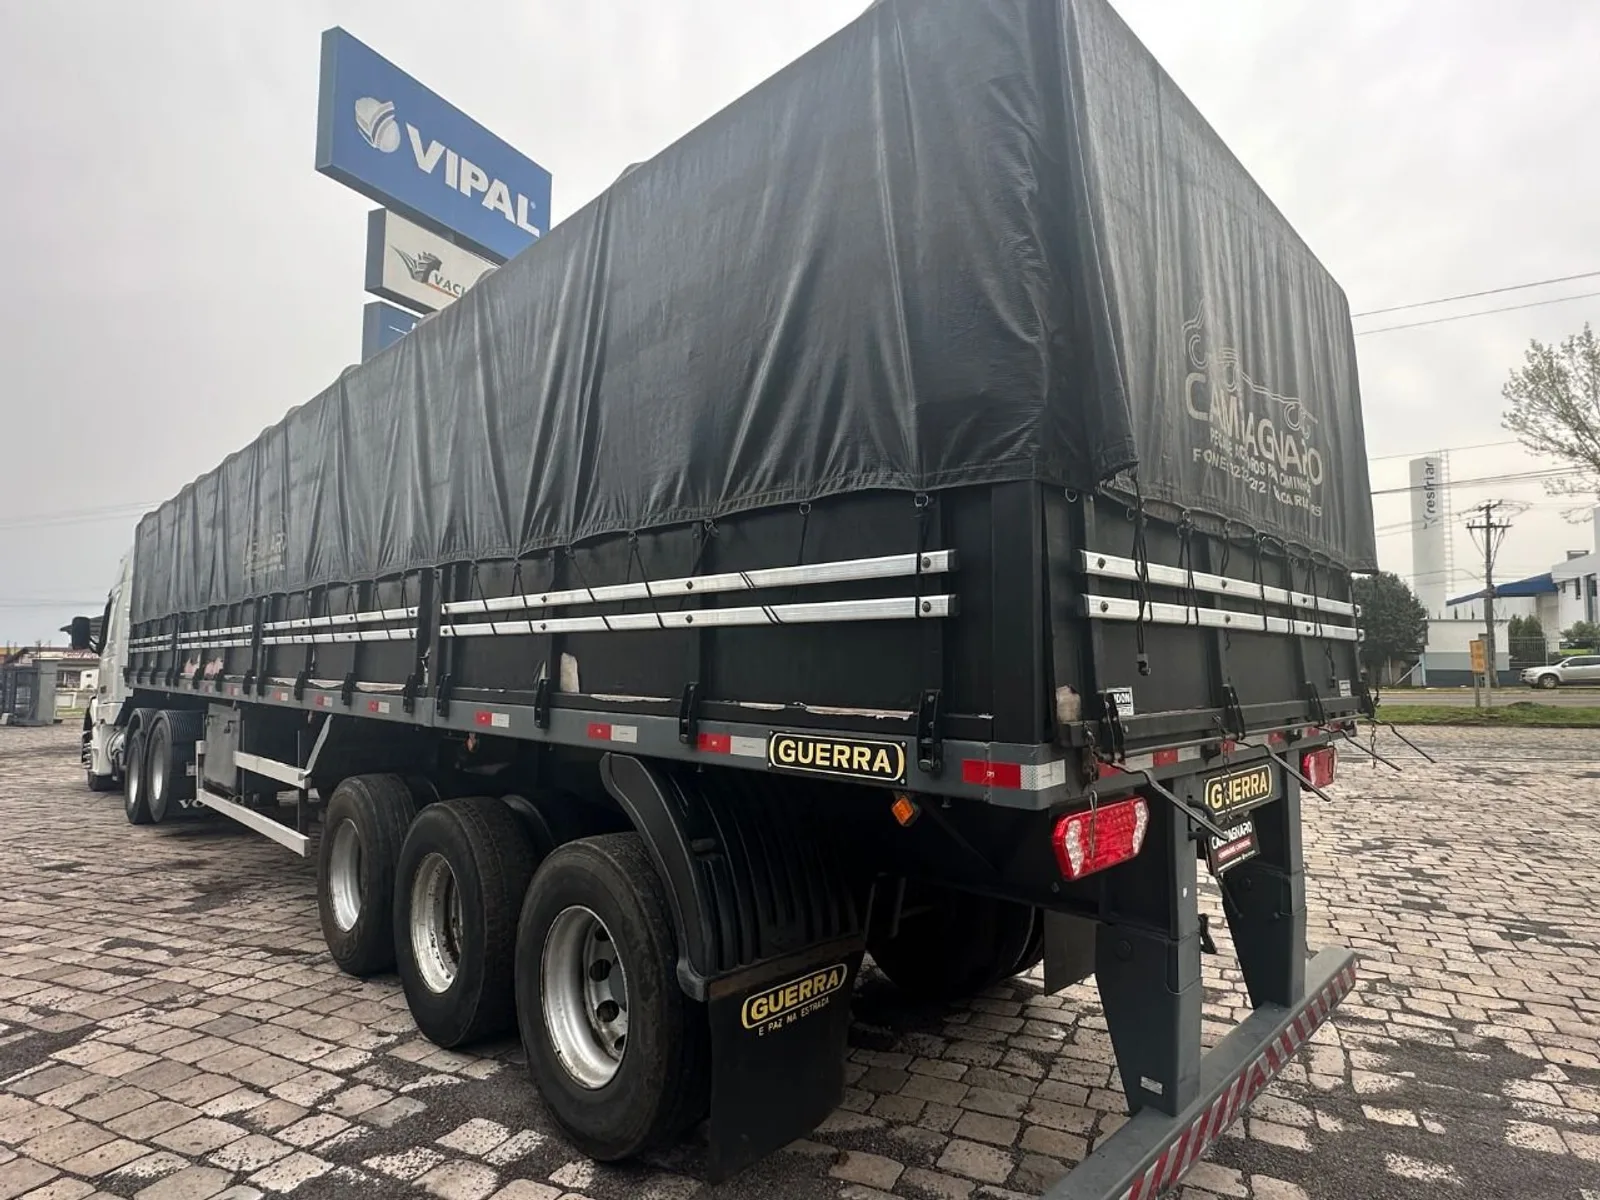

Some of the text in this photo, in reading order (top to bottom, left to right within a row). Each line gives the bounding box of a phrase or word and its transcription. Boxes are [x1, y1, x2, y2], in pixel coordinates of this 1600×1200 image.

[405, 121, 540, 238] VIPAL
[1425, 461, 1436, 514] resfriar
[778, 739, 892, 774] GUERRA
[751, 969, 839, 1020] GUERRA
[768, 1018, 783, 1032] PAZ
[787, 1012, 797, 1024] NA
[801, 996, 830, 1018] ESTRADA
